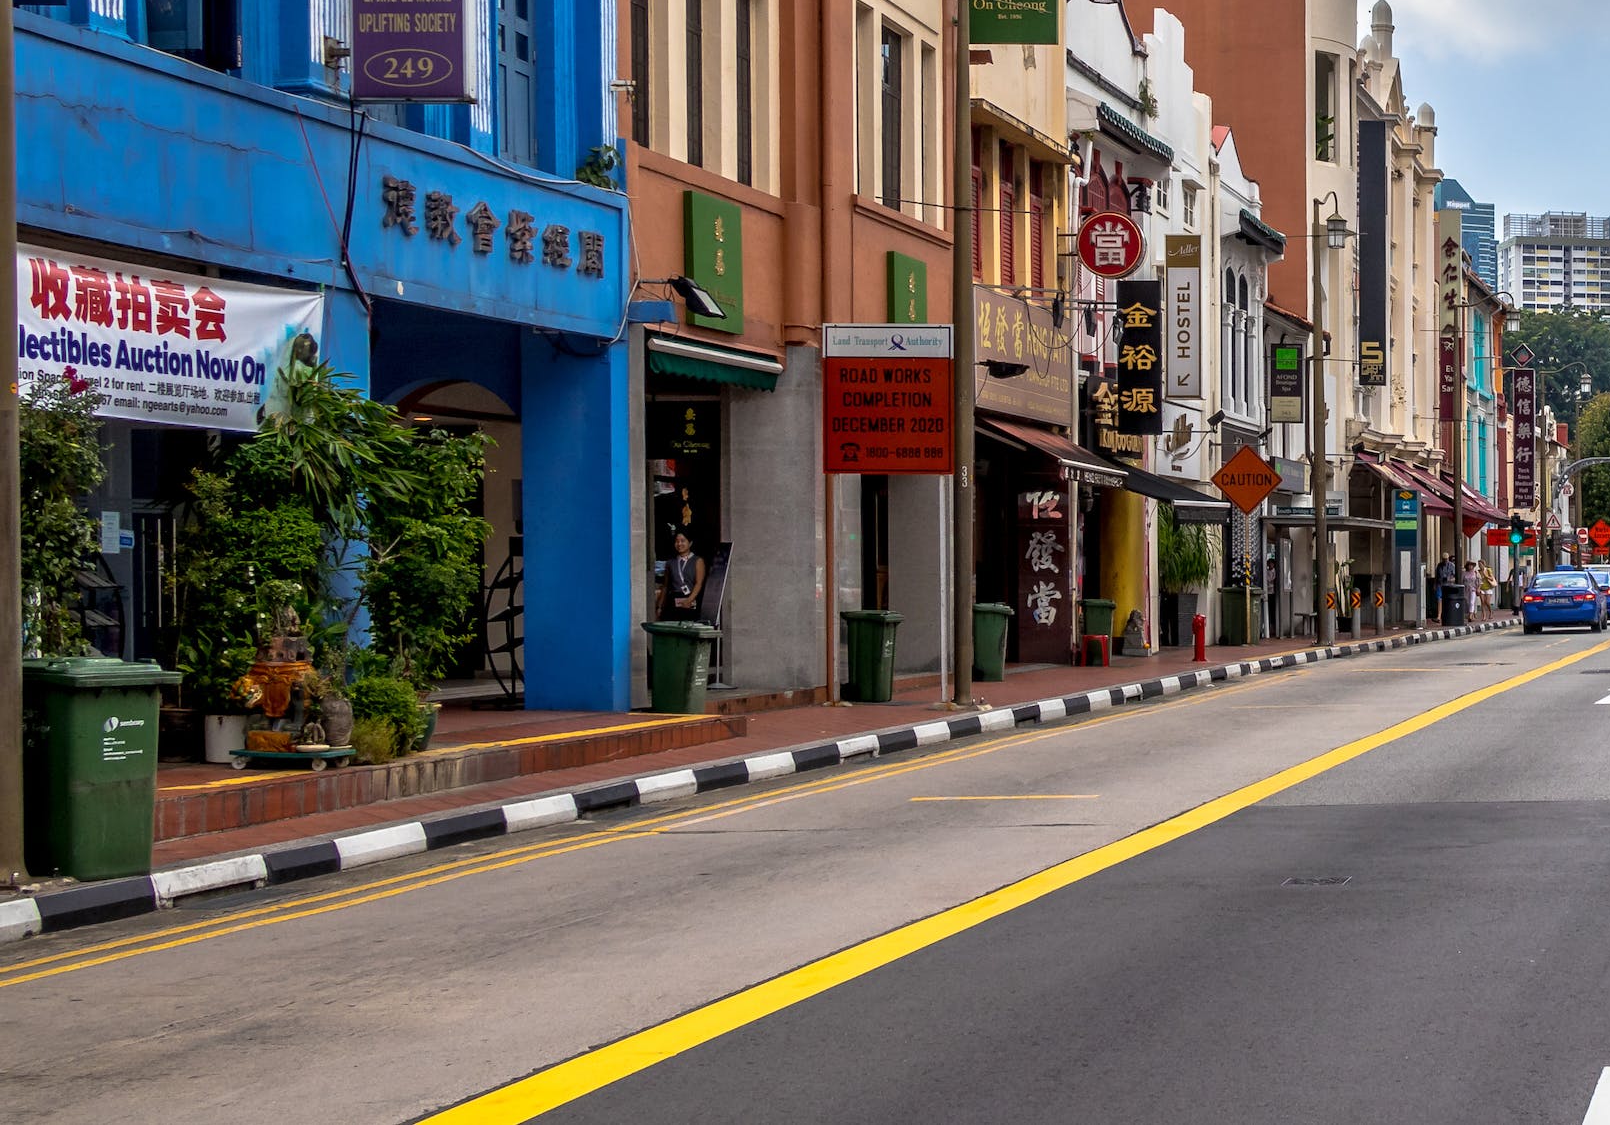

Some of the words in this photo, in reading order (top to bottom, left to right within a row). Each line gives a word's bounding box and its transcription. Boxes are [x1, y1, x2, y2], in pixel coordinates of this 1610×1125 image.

[359, 12, 411, 33] UPLIFTING
[414, 12, 456, 33] SOCIETY
[383, 57, 434, 79] 249
[1089, 220, 1131, 268] 當
[1168, 244, 1200, 257] Adler
[28, 258, 227, 344] 收藏拍卖会
[1177, 281, 1191, 359] HOSTEL
[832, 335, 851, 346] Land
[854, 336, 888, 348] Transport
[905, 335, 944, 347] Authority
[115, 339, 192, 379] Auction
[196, 349, 242, 383] Now
[241, 354, 266, 386] On
[1119, 302, 1158, 414] 金裕源
[1361, 341, 1384, 364] 5
[37, 369, 64, 384] Spac
[103, 377, 110, 389] 2
[112, 377, 125, 390] for
[839, 368, 878, 384] ROAD
[883, 368, 932, 384] WORKS
[1444, 374, 1454, 382] Ya
[114, 396, 140, 409] email:
[142, 400, 228, 416] ngeearts@yahoo.com
[842, 391, 932, 408] COMPLETION
[832, 416, 906, 433] DECEMBER
[910, 416, 945, 433] 2020
[1221, 473, 1273, 487] CAUTION
